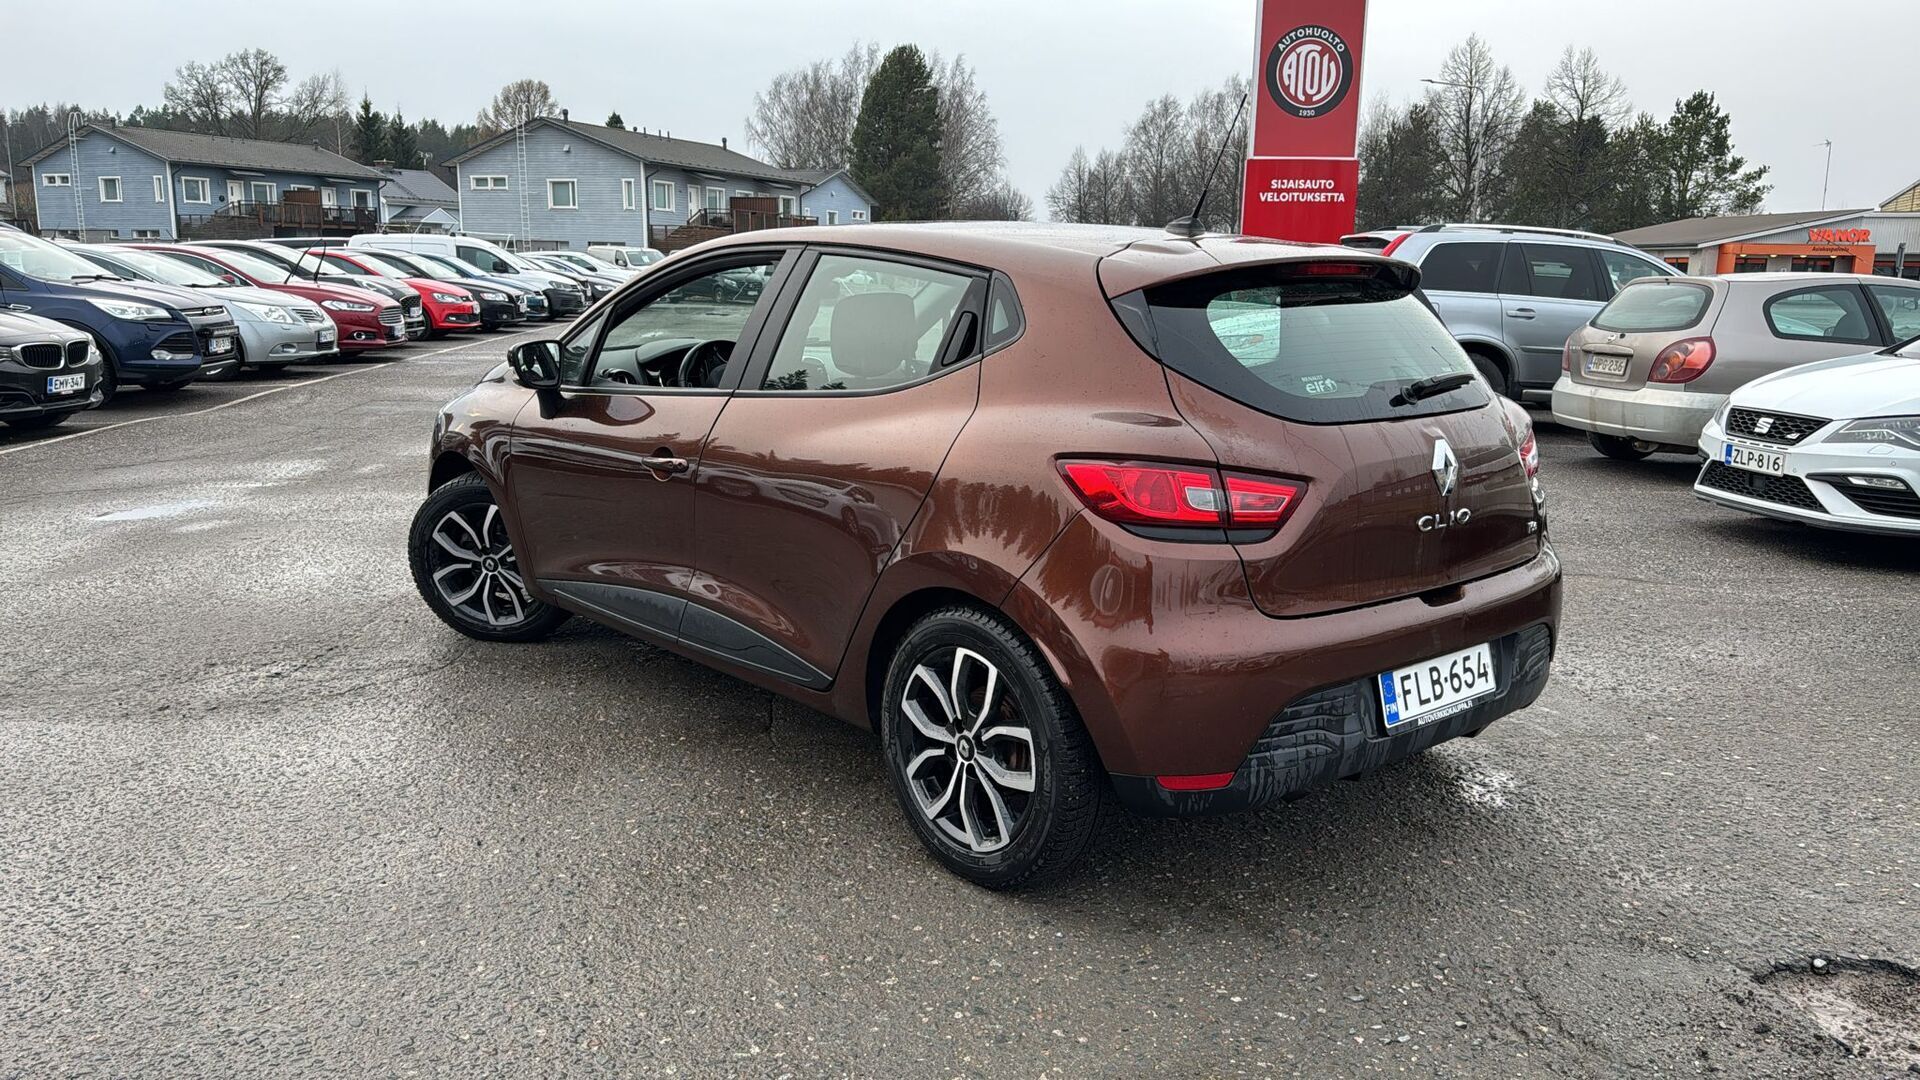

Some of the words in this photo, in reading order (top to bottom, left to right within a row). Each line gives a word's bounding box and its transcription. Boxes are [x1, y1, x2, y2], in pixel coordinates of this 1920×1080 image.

[1278, 27, 1345, 52] AUTOHUOLTO
[1298, 109, 1316, 117] 1930
[1270, 179, 1335, 190] SIJAISAUTO
[1259, 191, 1345, 203] VELOITUKSETTA
[1733, 448, 1781, 471] ZLP-816
[1418, 507, 1471, 532] CLIO
[1400, 651, 1489, 711] FLB-654
